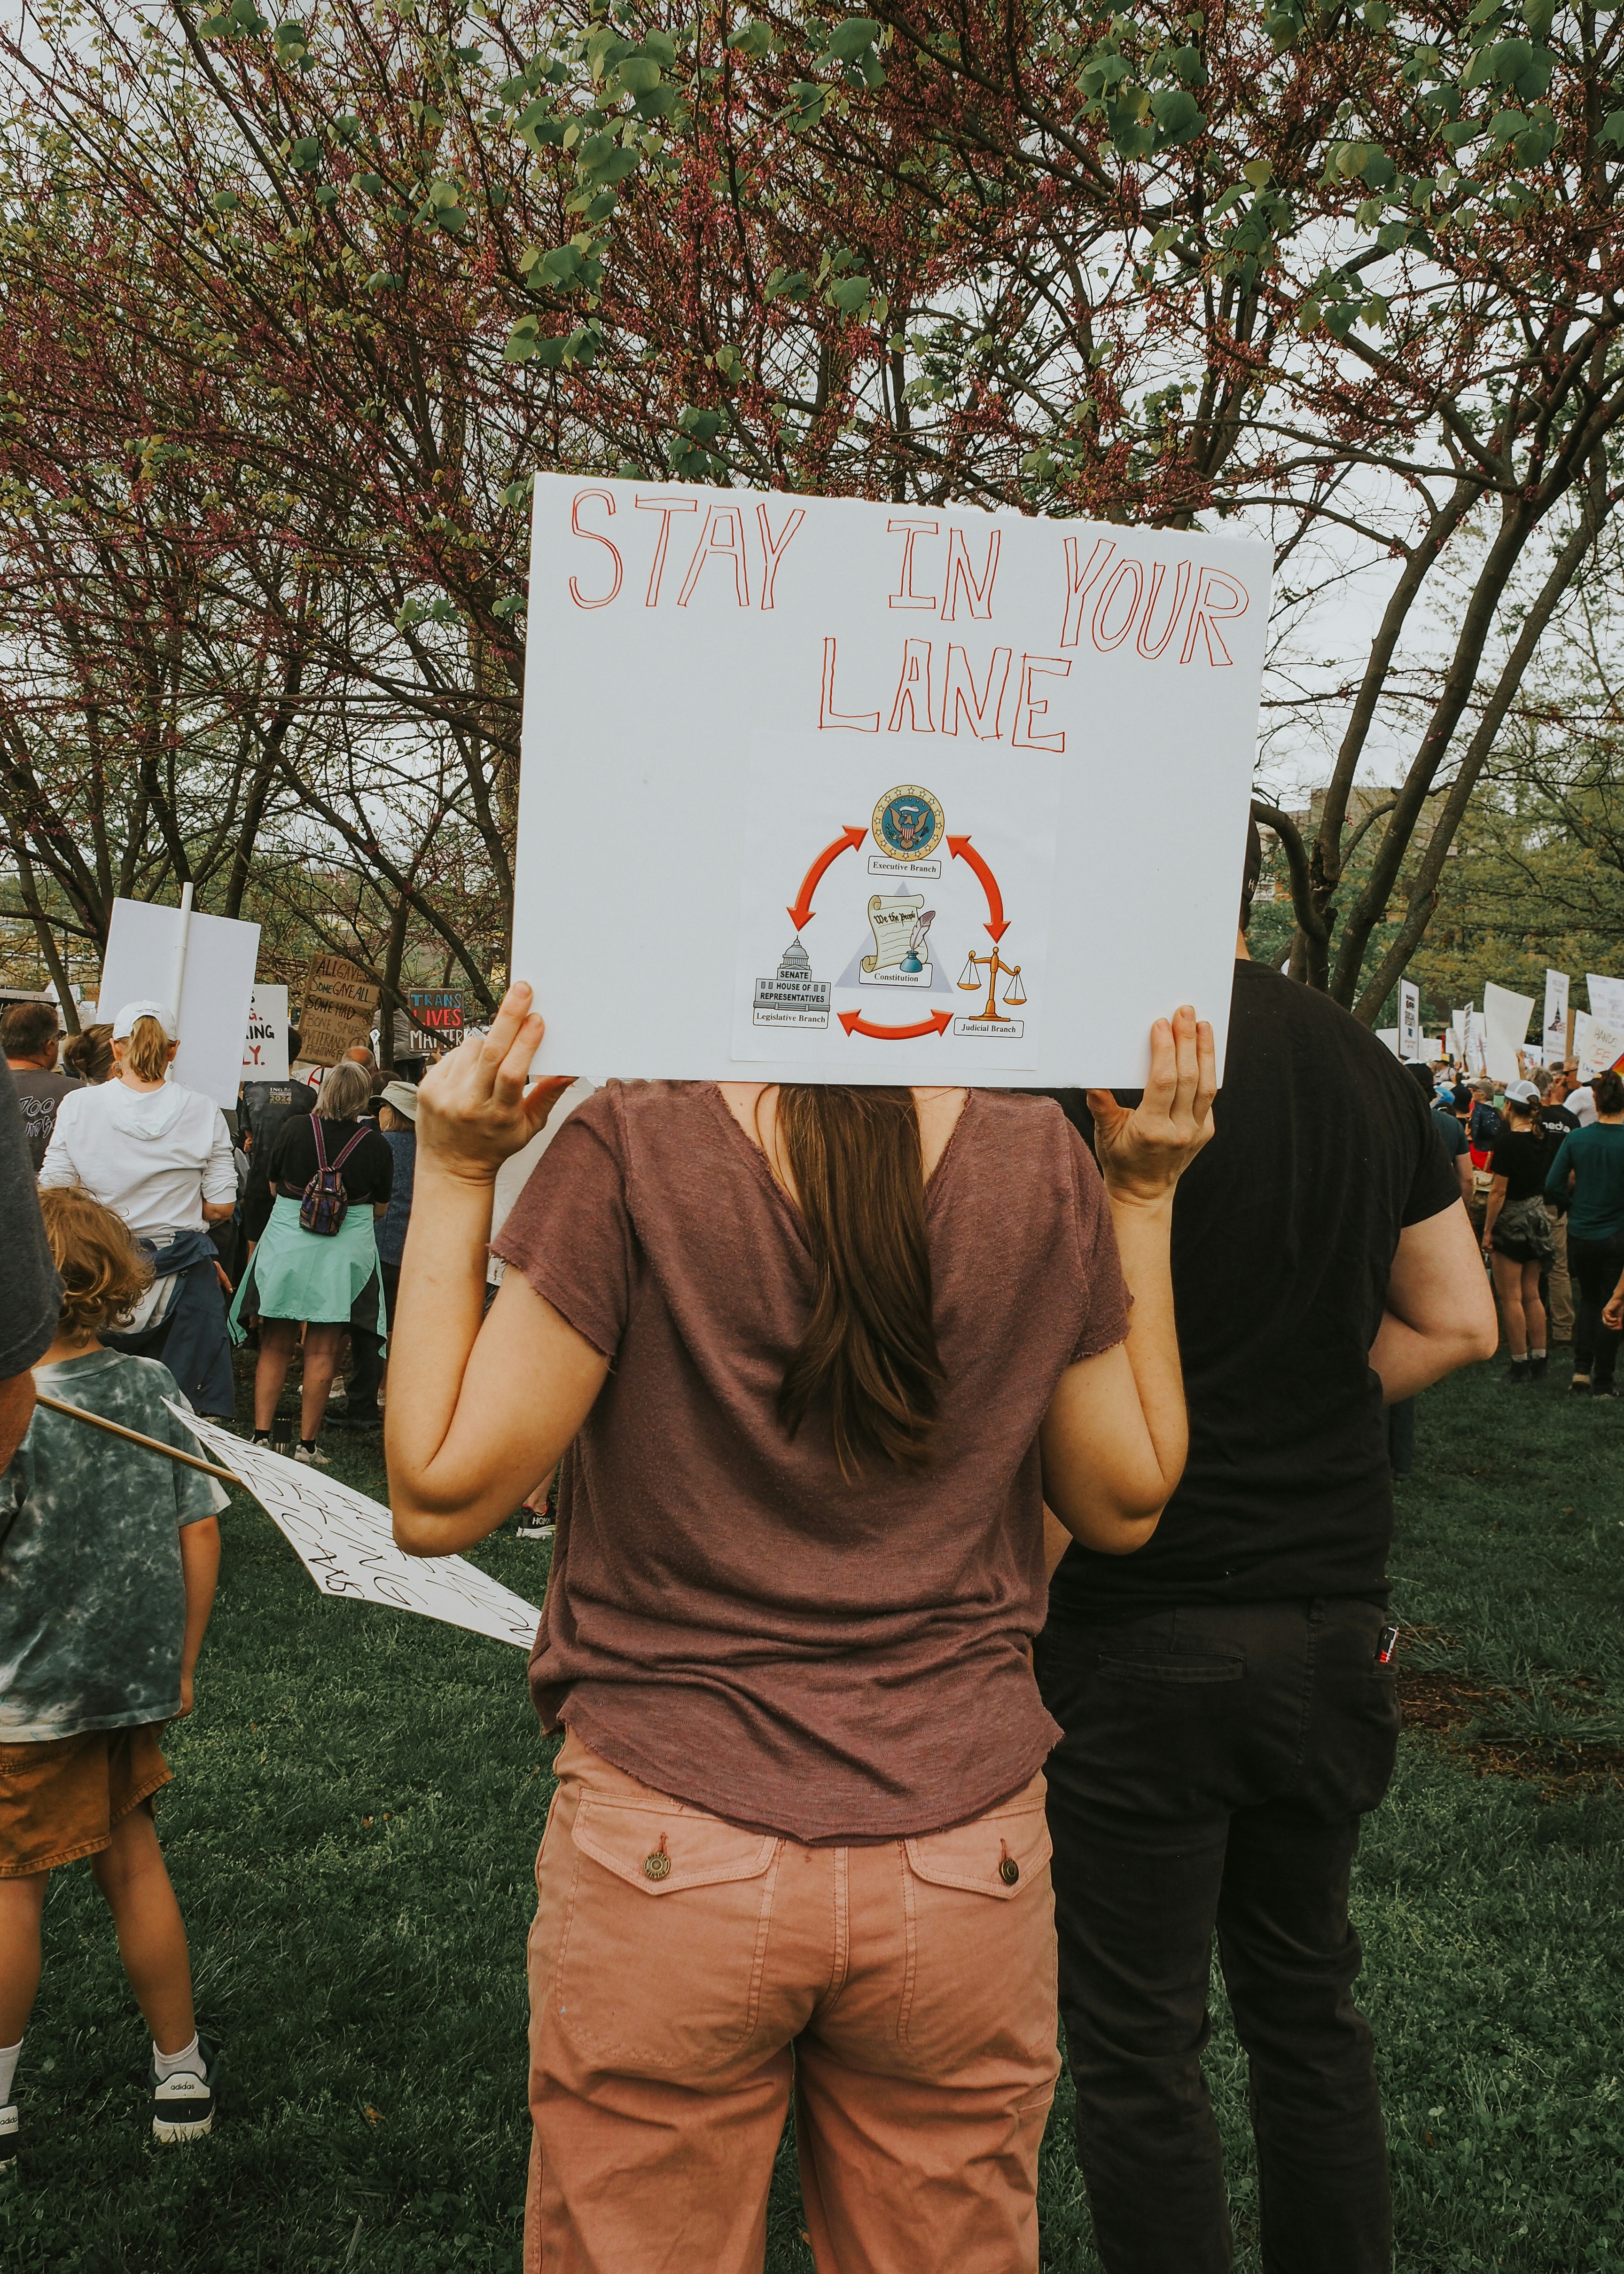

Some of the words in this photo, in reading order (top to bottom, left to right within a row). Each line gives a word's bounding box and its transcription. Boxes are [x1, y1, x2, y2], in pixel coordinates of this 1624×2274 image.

[569, 489, 806, 610] STAY
[887, 519, 1001, 621] IN
[1060, 536, 1250, 667] YOUR
[818, 636, 1072, 753] LANE
[873, 861, 908, 870] Executive
[910, 863, 937, 873] Branch
[874, 914, 888, 924] We
[888, 912, 899, 923] the
[316, 957, 337, 977] ALL
[337, 964, 362, 982] GAVE
[780, 971, 809, 979] SENATE
[874, 972, 919, 982] Constitution
[310, 975, 333, 995] SOME
[333, 981, 355, 998] GAVE
[776, 982, 800, 991] HOUSE
[410, 993, 461, 1009] TRANS
[760, 992, 825, 1003] REPRESENTATIVES
[305, 994, 334, 1014] SOME
[335, 1003, 356, 1020] HAD
[756, 1012, 796, 1022] Legislative
[798, 1014, 826, 1023] Branch
[245, 1024, 275, 1040] ING
[169, 1402, 365, 1599] AMERICANS
[227, 1436, 428, 1606] WORKING
[170, 2081, 195, 2091] adidas
